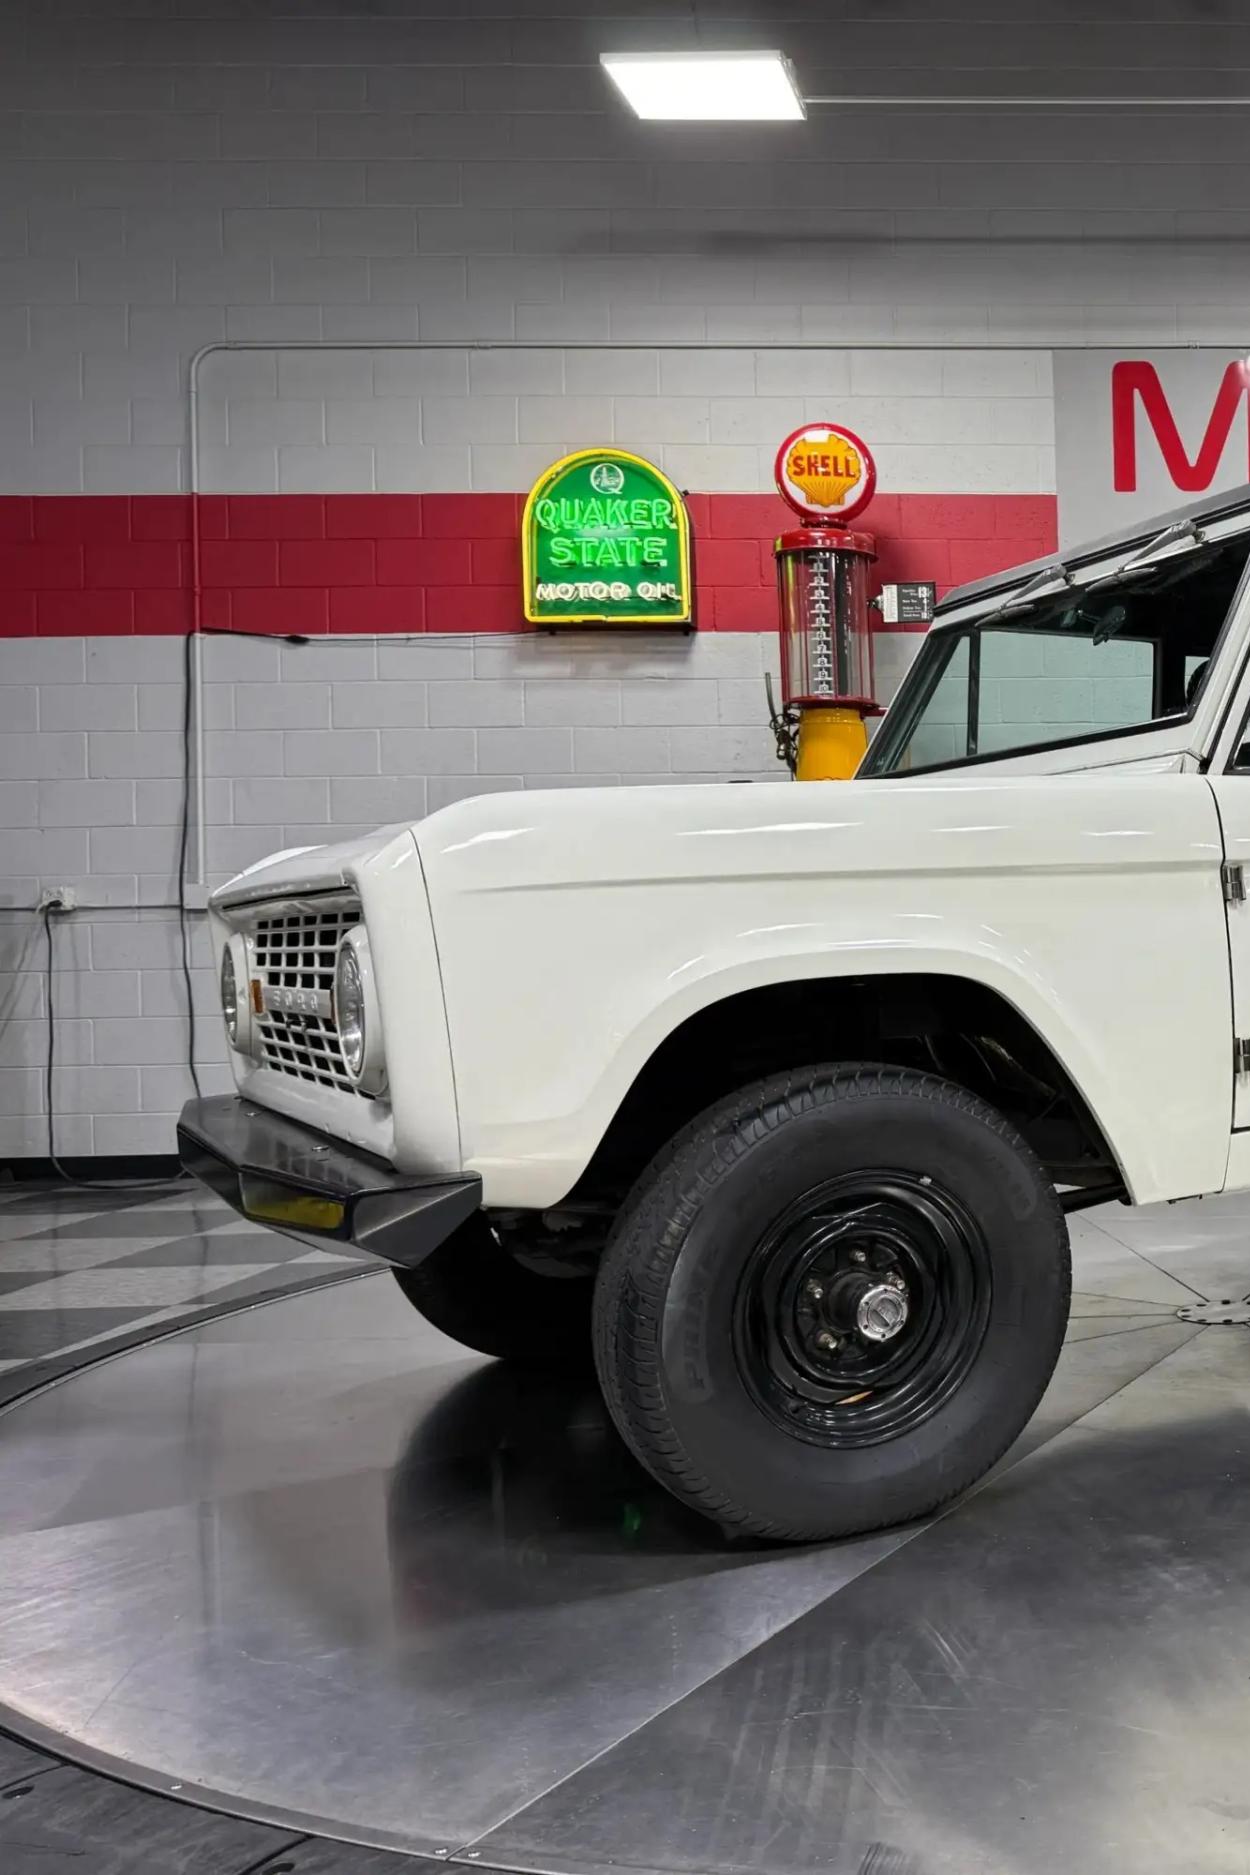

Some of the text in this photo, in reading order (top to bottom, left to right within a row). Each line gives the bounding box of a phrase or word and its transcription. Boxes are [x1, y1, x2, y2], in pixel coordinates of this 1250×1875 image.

[792, 454, 856, 478] SHELL
[535, 497, 678, 534] QUAKER
[549, 536, 668, 567] STATE
[536, 581, 681, 601] MOTOR OIL
